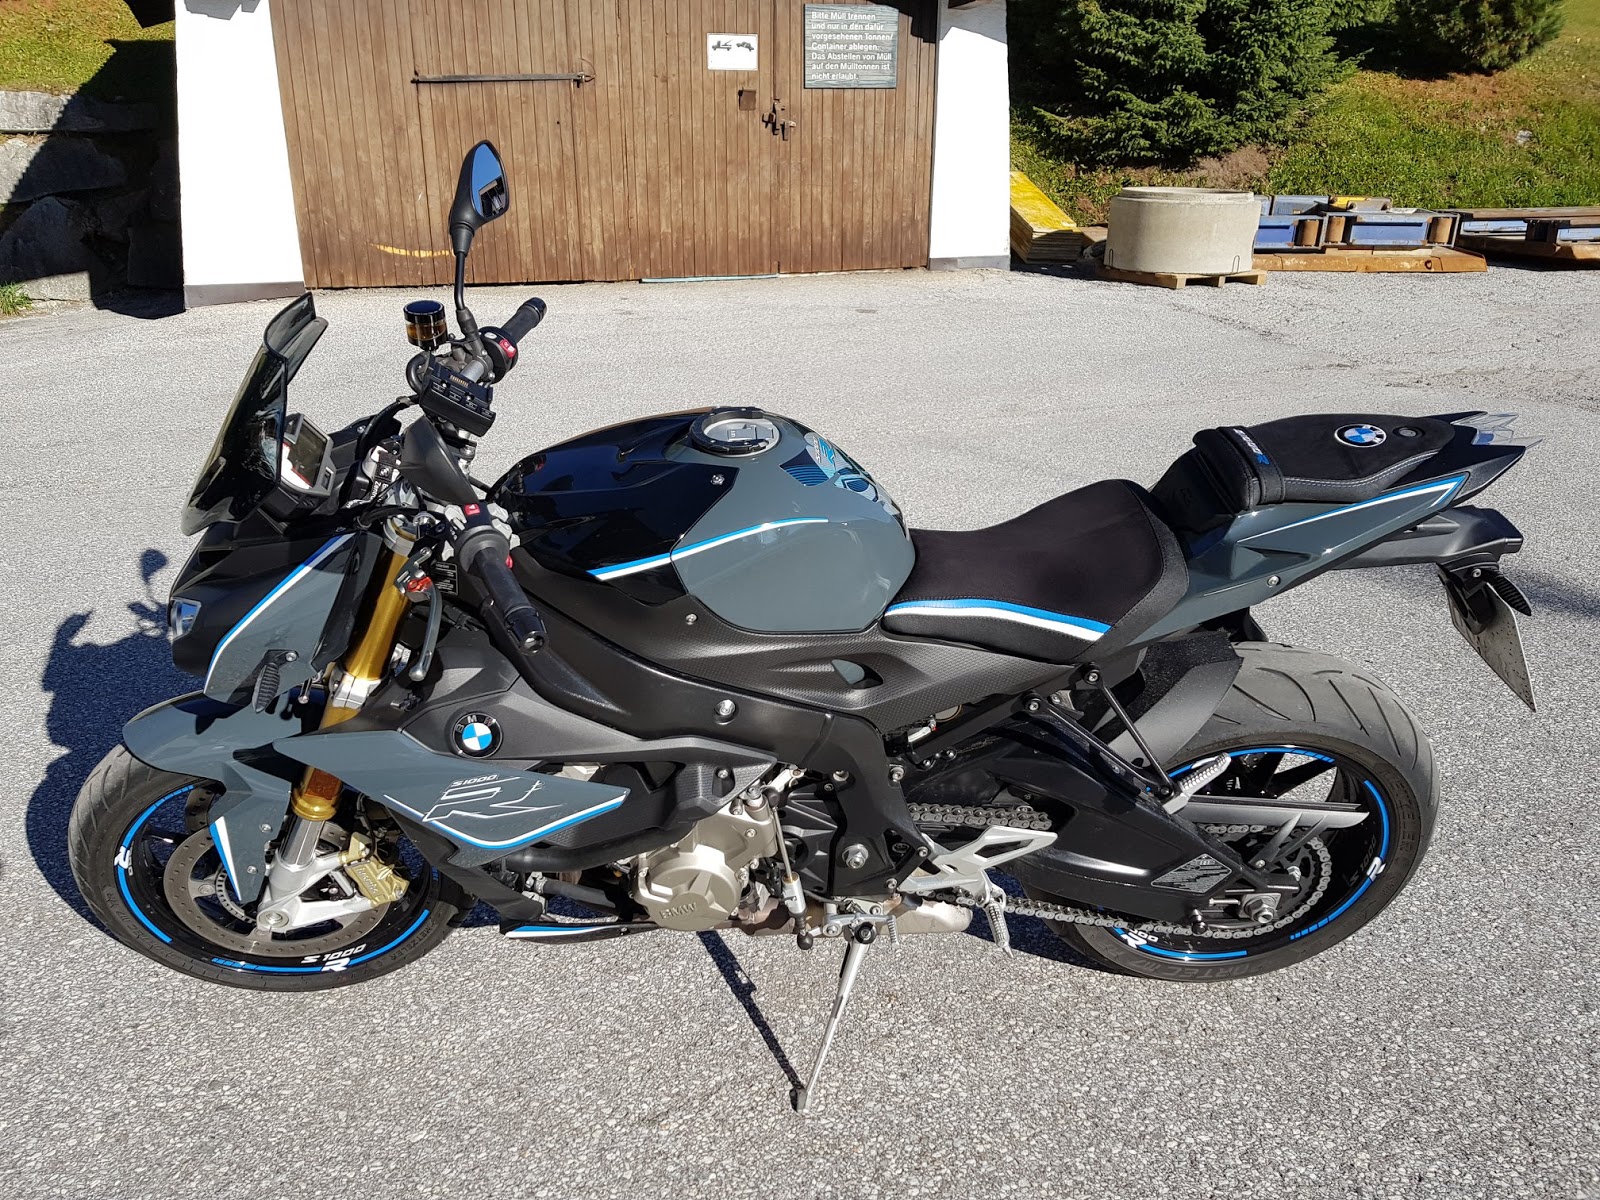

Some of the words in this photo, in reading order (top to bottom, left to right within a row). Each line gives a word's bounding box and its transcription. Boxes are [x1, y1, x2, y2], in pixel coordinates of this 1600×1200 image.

[811, 11, 829, 20] Bitte
[830, 11, 847, 20] Müll
[847, 12, 876, 20] trennen
[811, 22, 826, 30] und
[841, 22, 848, 30] in
[849, 22, 864, 30] den
[864, 22, 884, 31] dafür
[811, 32, 863, 41] vorgesehenen
[811, 42, 847, 50] Container
[811, 52, 826, 60] Das
[827, 52, 861, 61] Abstellen
[862, 53, 876, 61] von
[876, 52, 892, 61] Müll
[811, 62, 824, 70] auf
[825, 62, 839, 70] den
[840, 62, 880, 71] Mülltonnen
[881, 62, 890, 70] ist
[811, 72, 830, 80] nicht
[659, 902, 697, 919] BMW
[301, 955, 321, 964] S
[322, 943, 367, 962] 1000
[321, 957, 351, 972] R
